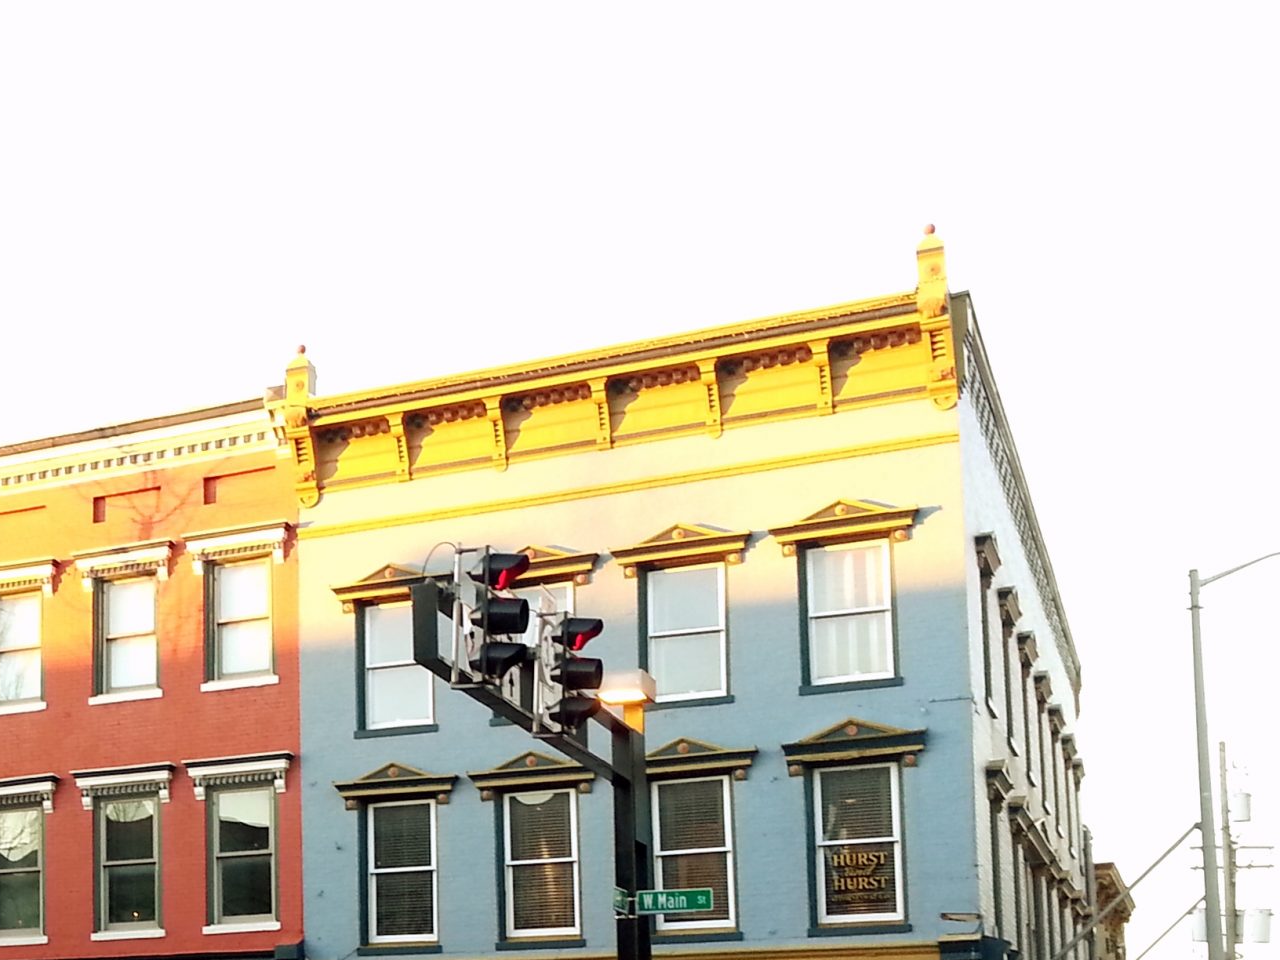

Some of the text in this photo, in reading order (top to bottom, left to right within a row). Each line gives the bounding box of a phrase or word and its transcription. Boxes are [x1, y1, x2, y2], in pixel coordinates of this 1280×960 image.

[832, 851, 888, 867] HURST
[832, 876, 889, 891] HURST
[657, 892, 687, 909] Main
